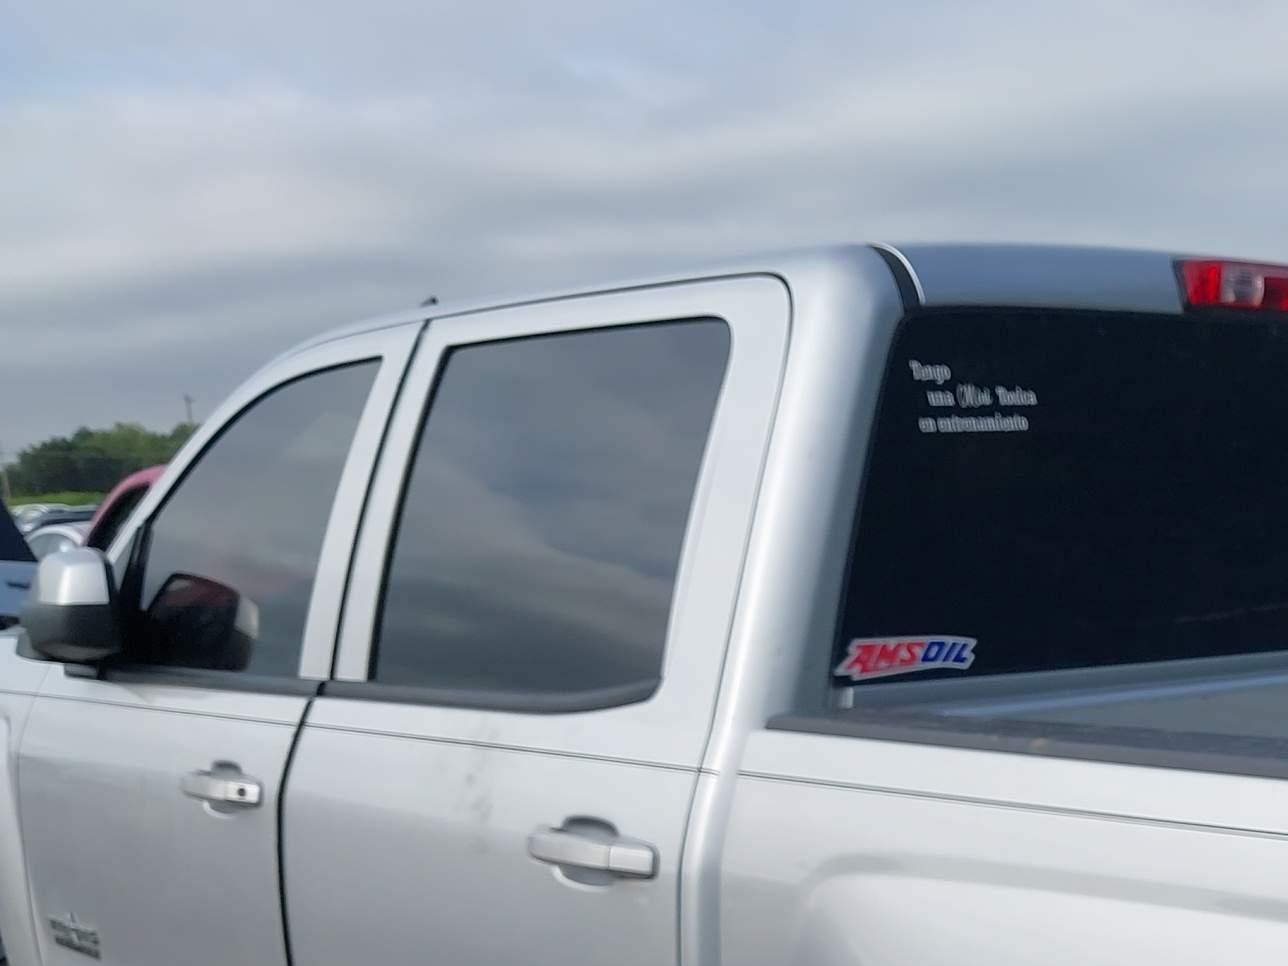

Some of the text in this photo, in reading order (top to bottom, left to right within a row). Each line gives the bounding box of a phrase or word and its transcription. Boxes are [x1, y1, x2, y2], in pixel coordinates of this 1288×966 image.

[908, 359, 951, 385] Tengo
[926, 390, 956, 407] una
[918, 411, 1029, 433] en entrenamiento
[845, 640, 970, 675] AMSOIL
